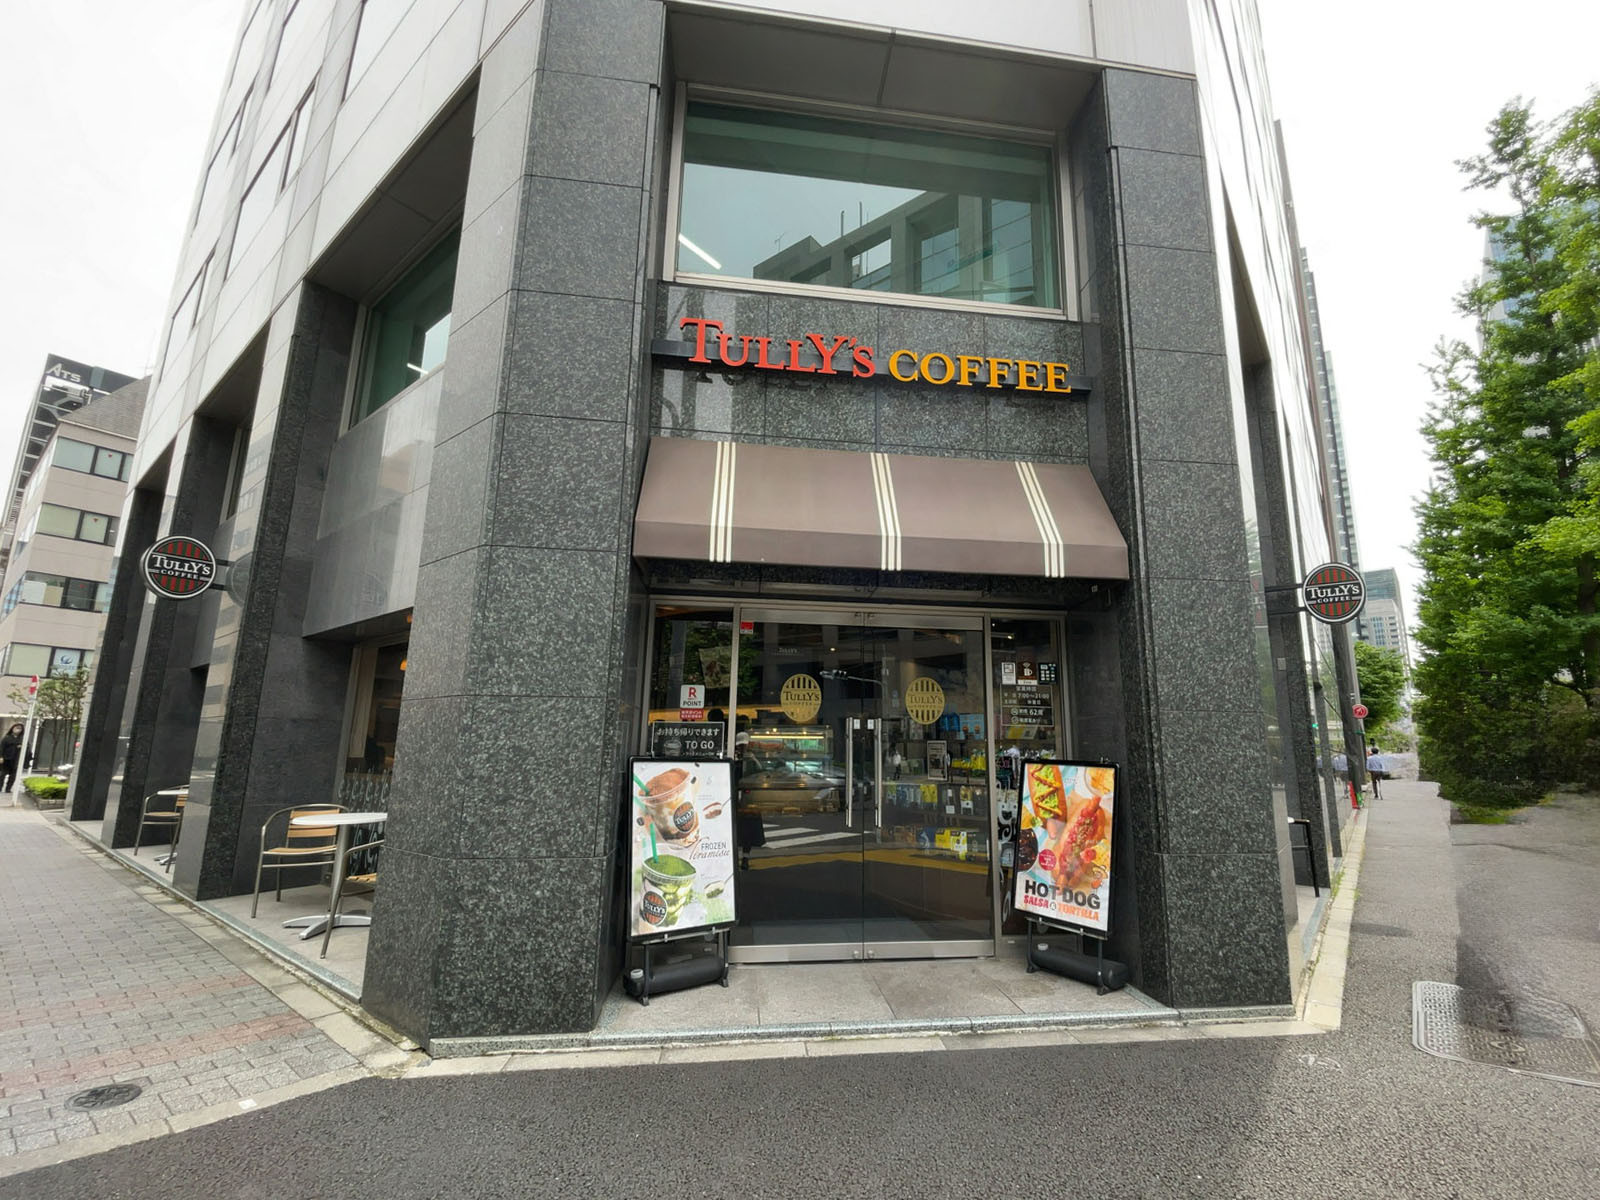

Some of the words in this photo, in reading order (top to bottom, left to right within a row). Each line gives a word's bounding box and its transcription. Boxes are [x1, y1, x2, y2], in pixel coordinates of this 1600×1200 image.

[680, 317, 876, 378] TULLY'S
[888, 349, 1072, 393] COFFEE
[46, 363, 81, 382] ATS
[152, 554, 211, 576] TULLY'S
[161, 569, 199, 579] COFFEE
[1306, 584, 1360, 599] TULLY'S
[1317, 596, 1351, 604] COFFEE
[688, 686, 697, 698] R
[783, 691, 820, 702] TULLY'S
[656, 727, 720, 736] お持ち帰りできます
[685, 740, 698, 749] TO
[700, 740, 715, 749] GO
[701, 842, 727, 851] FROZEN
[1025, 879, 1060, 901] HOT
[1062, 887, 1101, 910] DOG
[1023, 894, 1049, 909] SALSA
[1057, 902, 1100, 921] TORTILLA
